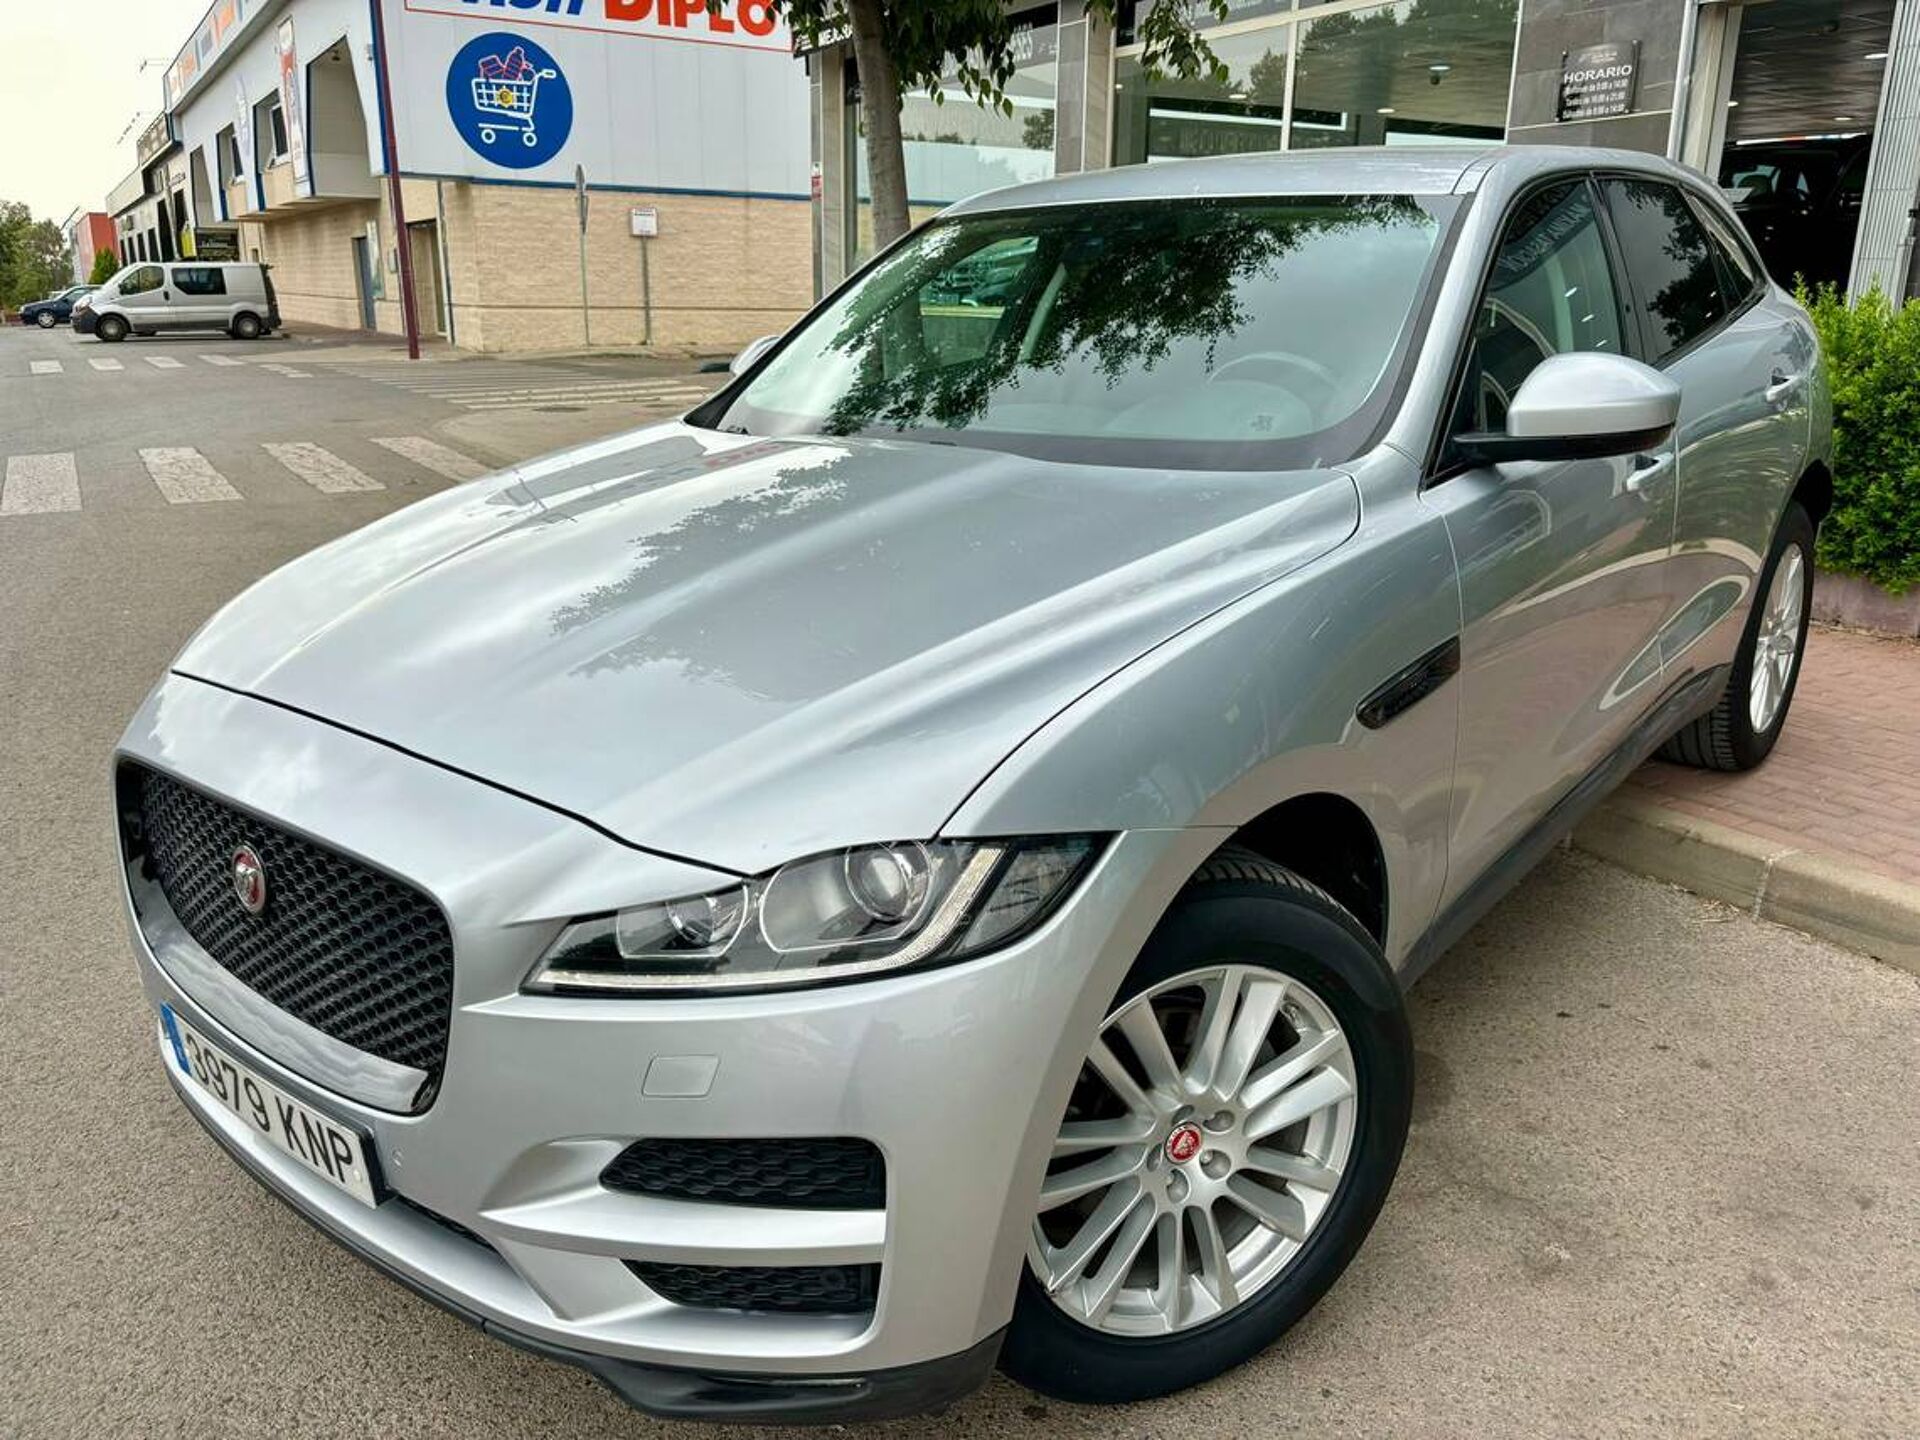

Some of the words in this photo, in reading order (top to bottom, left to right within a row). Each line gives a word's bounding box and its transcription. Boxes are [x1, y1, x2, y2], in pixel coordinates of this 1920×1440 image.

[1563, 64, 1632, 83] HORARIO
[186, 1032, 271, 1132] 3979
[275, 1094, 353, 1184] KNP
